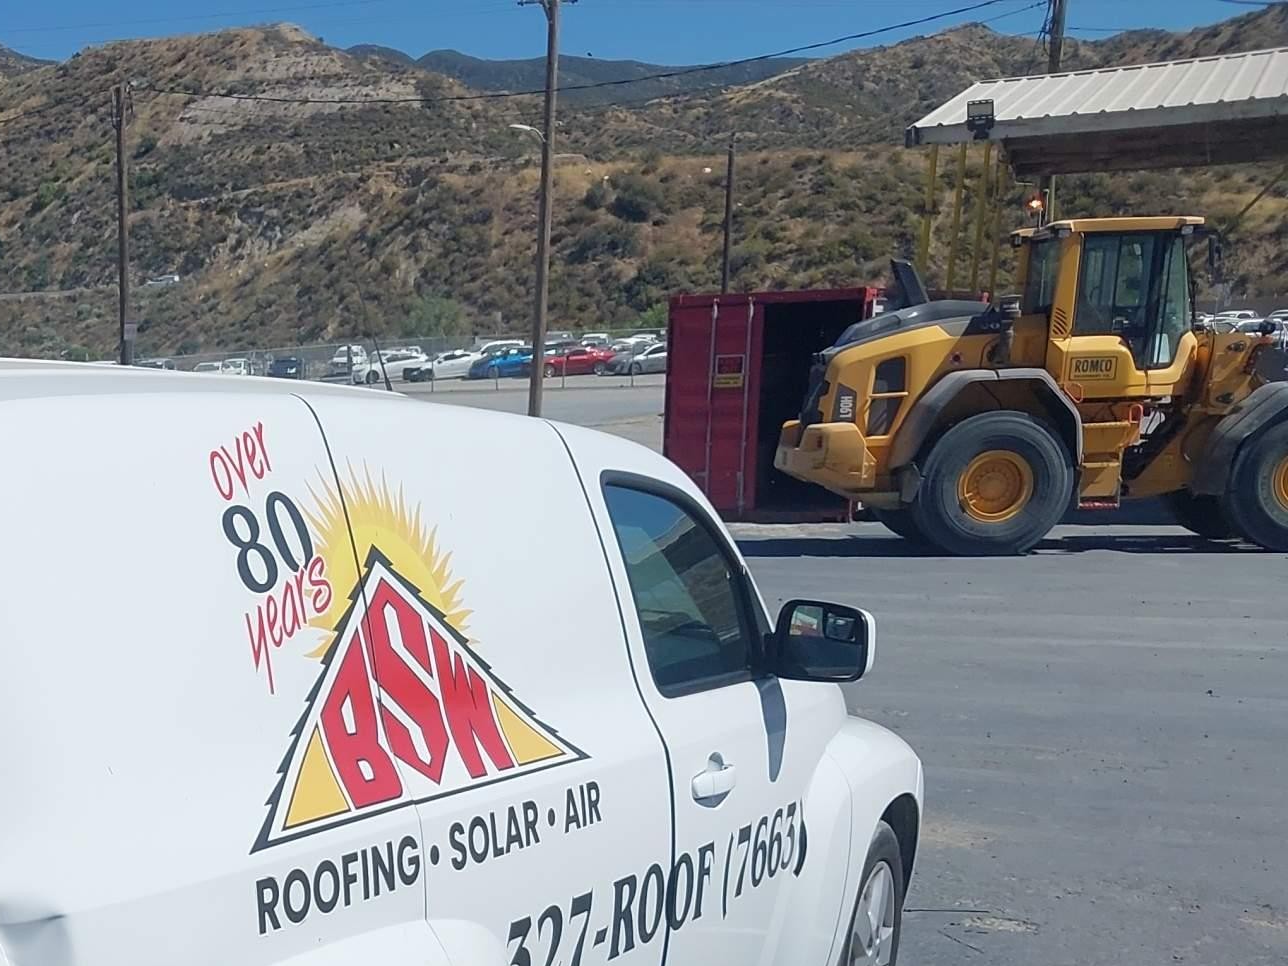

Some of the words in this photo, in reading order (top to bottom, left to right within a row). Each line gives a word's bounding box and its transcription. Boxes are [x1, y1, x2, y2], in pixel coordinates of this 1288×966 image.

[839, 395, 854, 418] L90H
[1074, 359, 1113, 373] ROMCO
[221, 491, 314, 594] 80
[244, 556, 333, 696] years
[320, 577, 514, 810] BSW
[255, 835, 421, 935] ROOFING
[448, 800, 540, 871] SOLAR
[564, 781, 603, 834] AIR
[722, 795, 809, 920] (7663)
